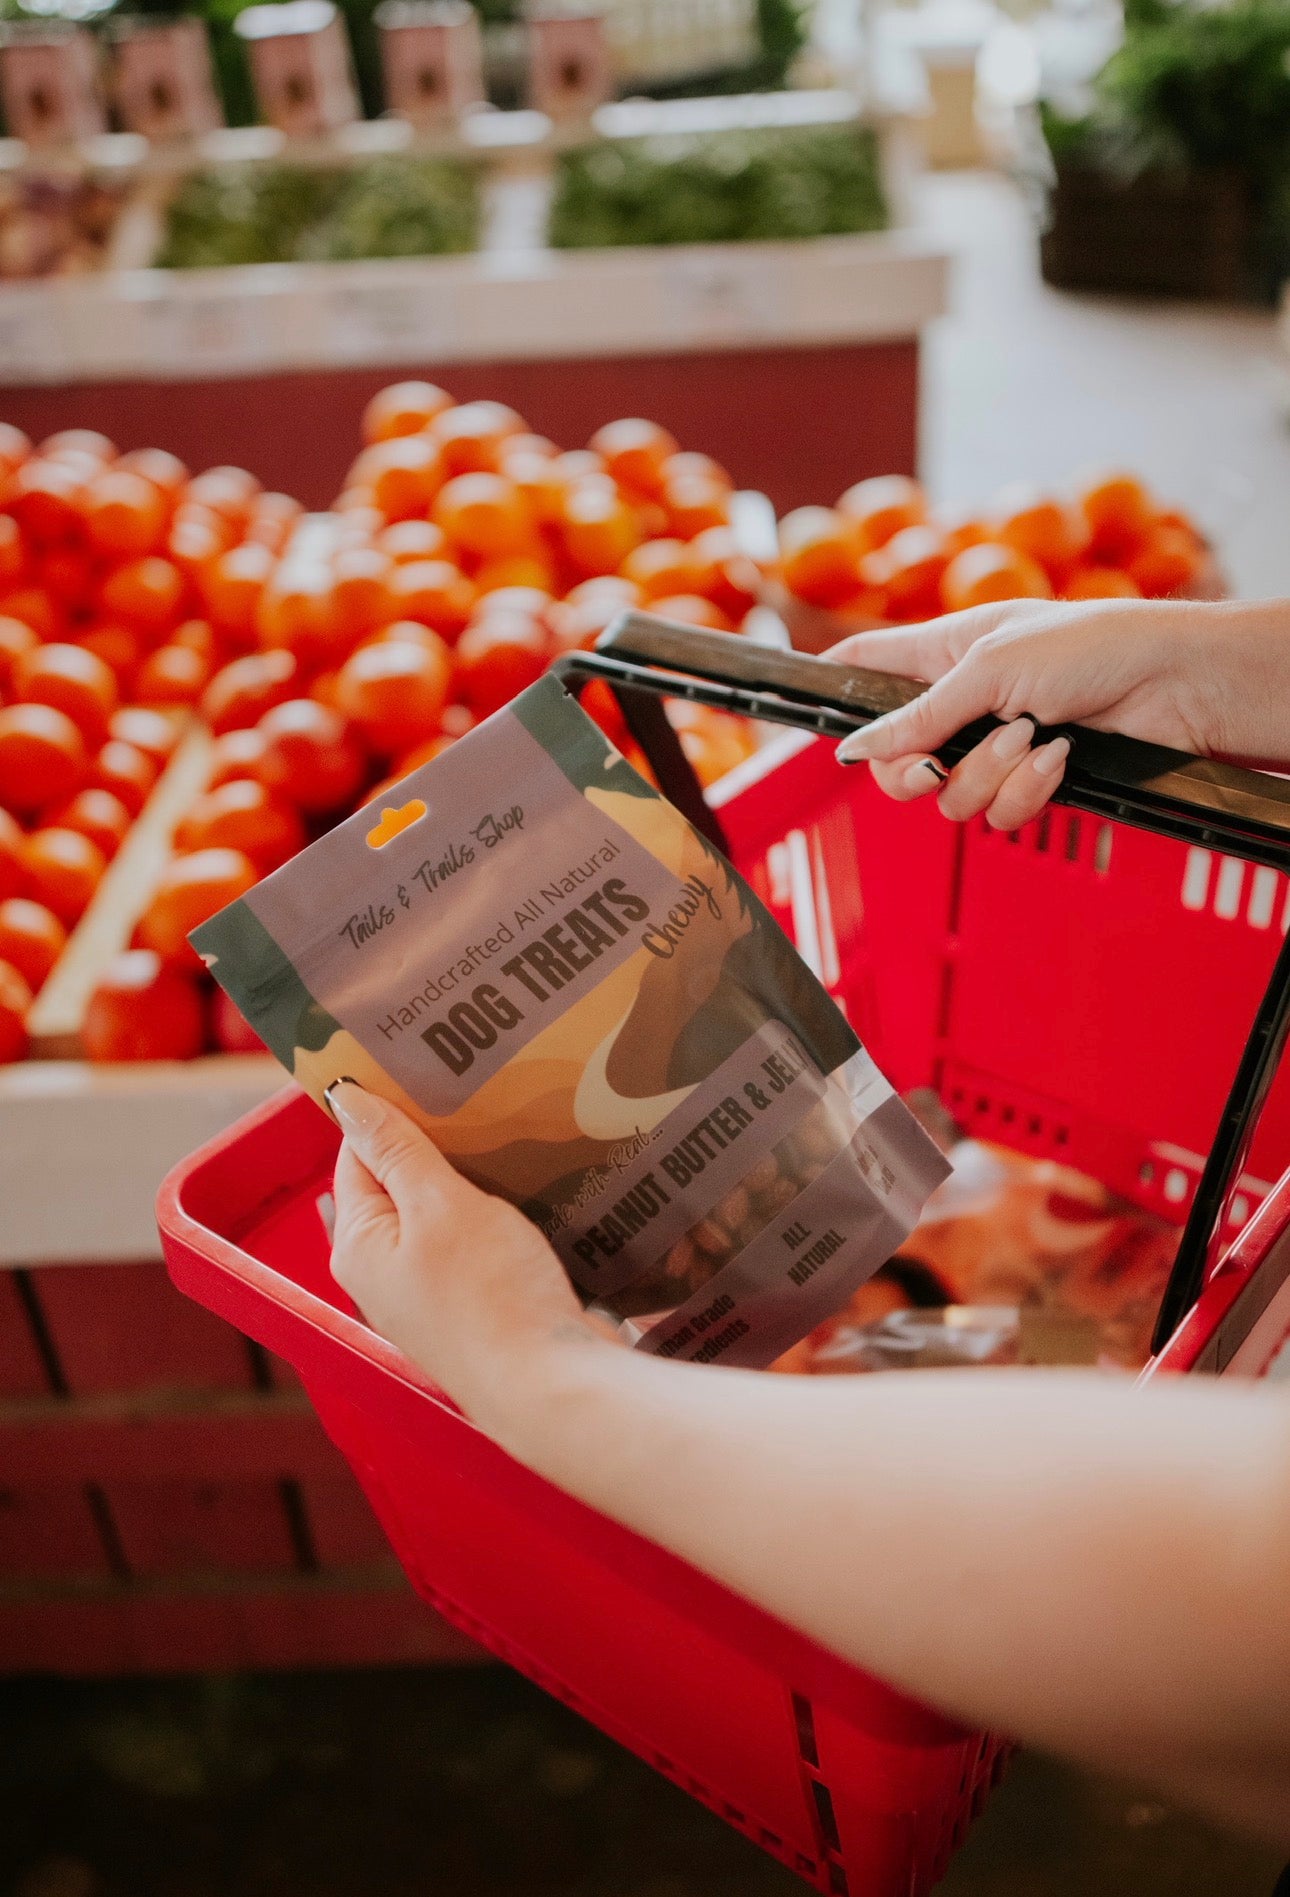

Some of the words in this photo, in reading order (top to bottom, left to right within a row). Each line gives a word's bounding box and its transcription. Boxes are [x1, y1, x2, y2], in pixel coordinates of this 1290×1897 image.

[338, 904, 396, 950] Tails
[397, 884, 410, 909] &
[411, 844, 475, 893] Trails
[469, 805, 524, 848] Shop
[376, 921, 515, 1041] Handcrafted
[513, 897, 547, 931] All
[548, 838, 622, 904] Natural
[420, 983, 527, 1078] DOG
[500, 877, 652, 1003] TREATS
[543, 1205, 574, 1237] ade
[574, 1168, 610, 1208] with
[571, 1172, 671, 1271] PEANUT
[659, 1096, 755, 1189] BUTTER
[743, 1082, 773, 1110] &
[781, 1222, 813, 1251] ALL
[787, 1229, 847, 1287] NATURAL
[690, 1294, 736, 1333] Grade
